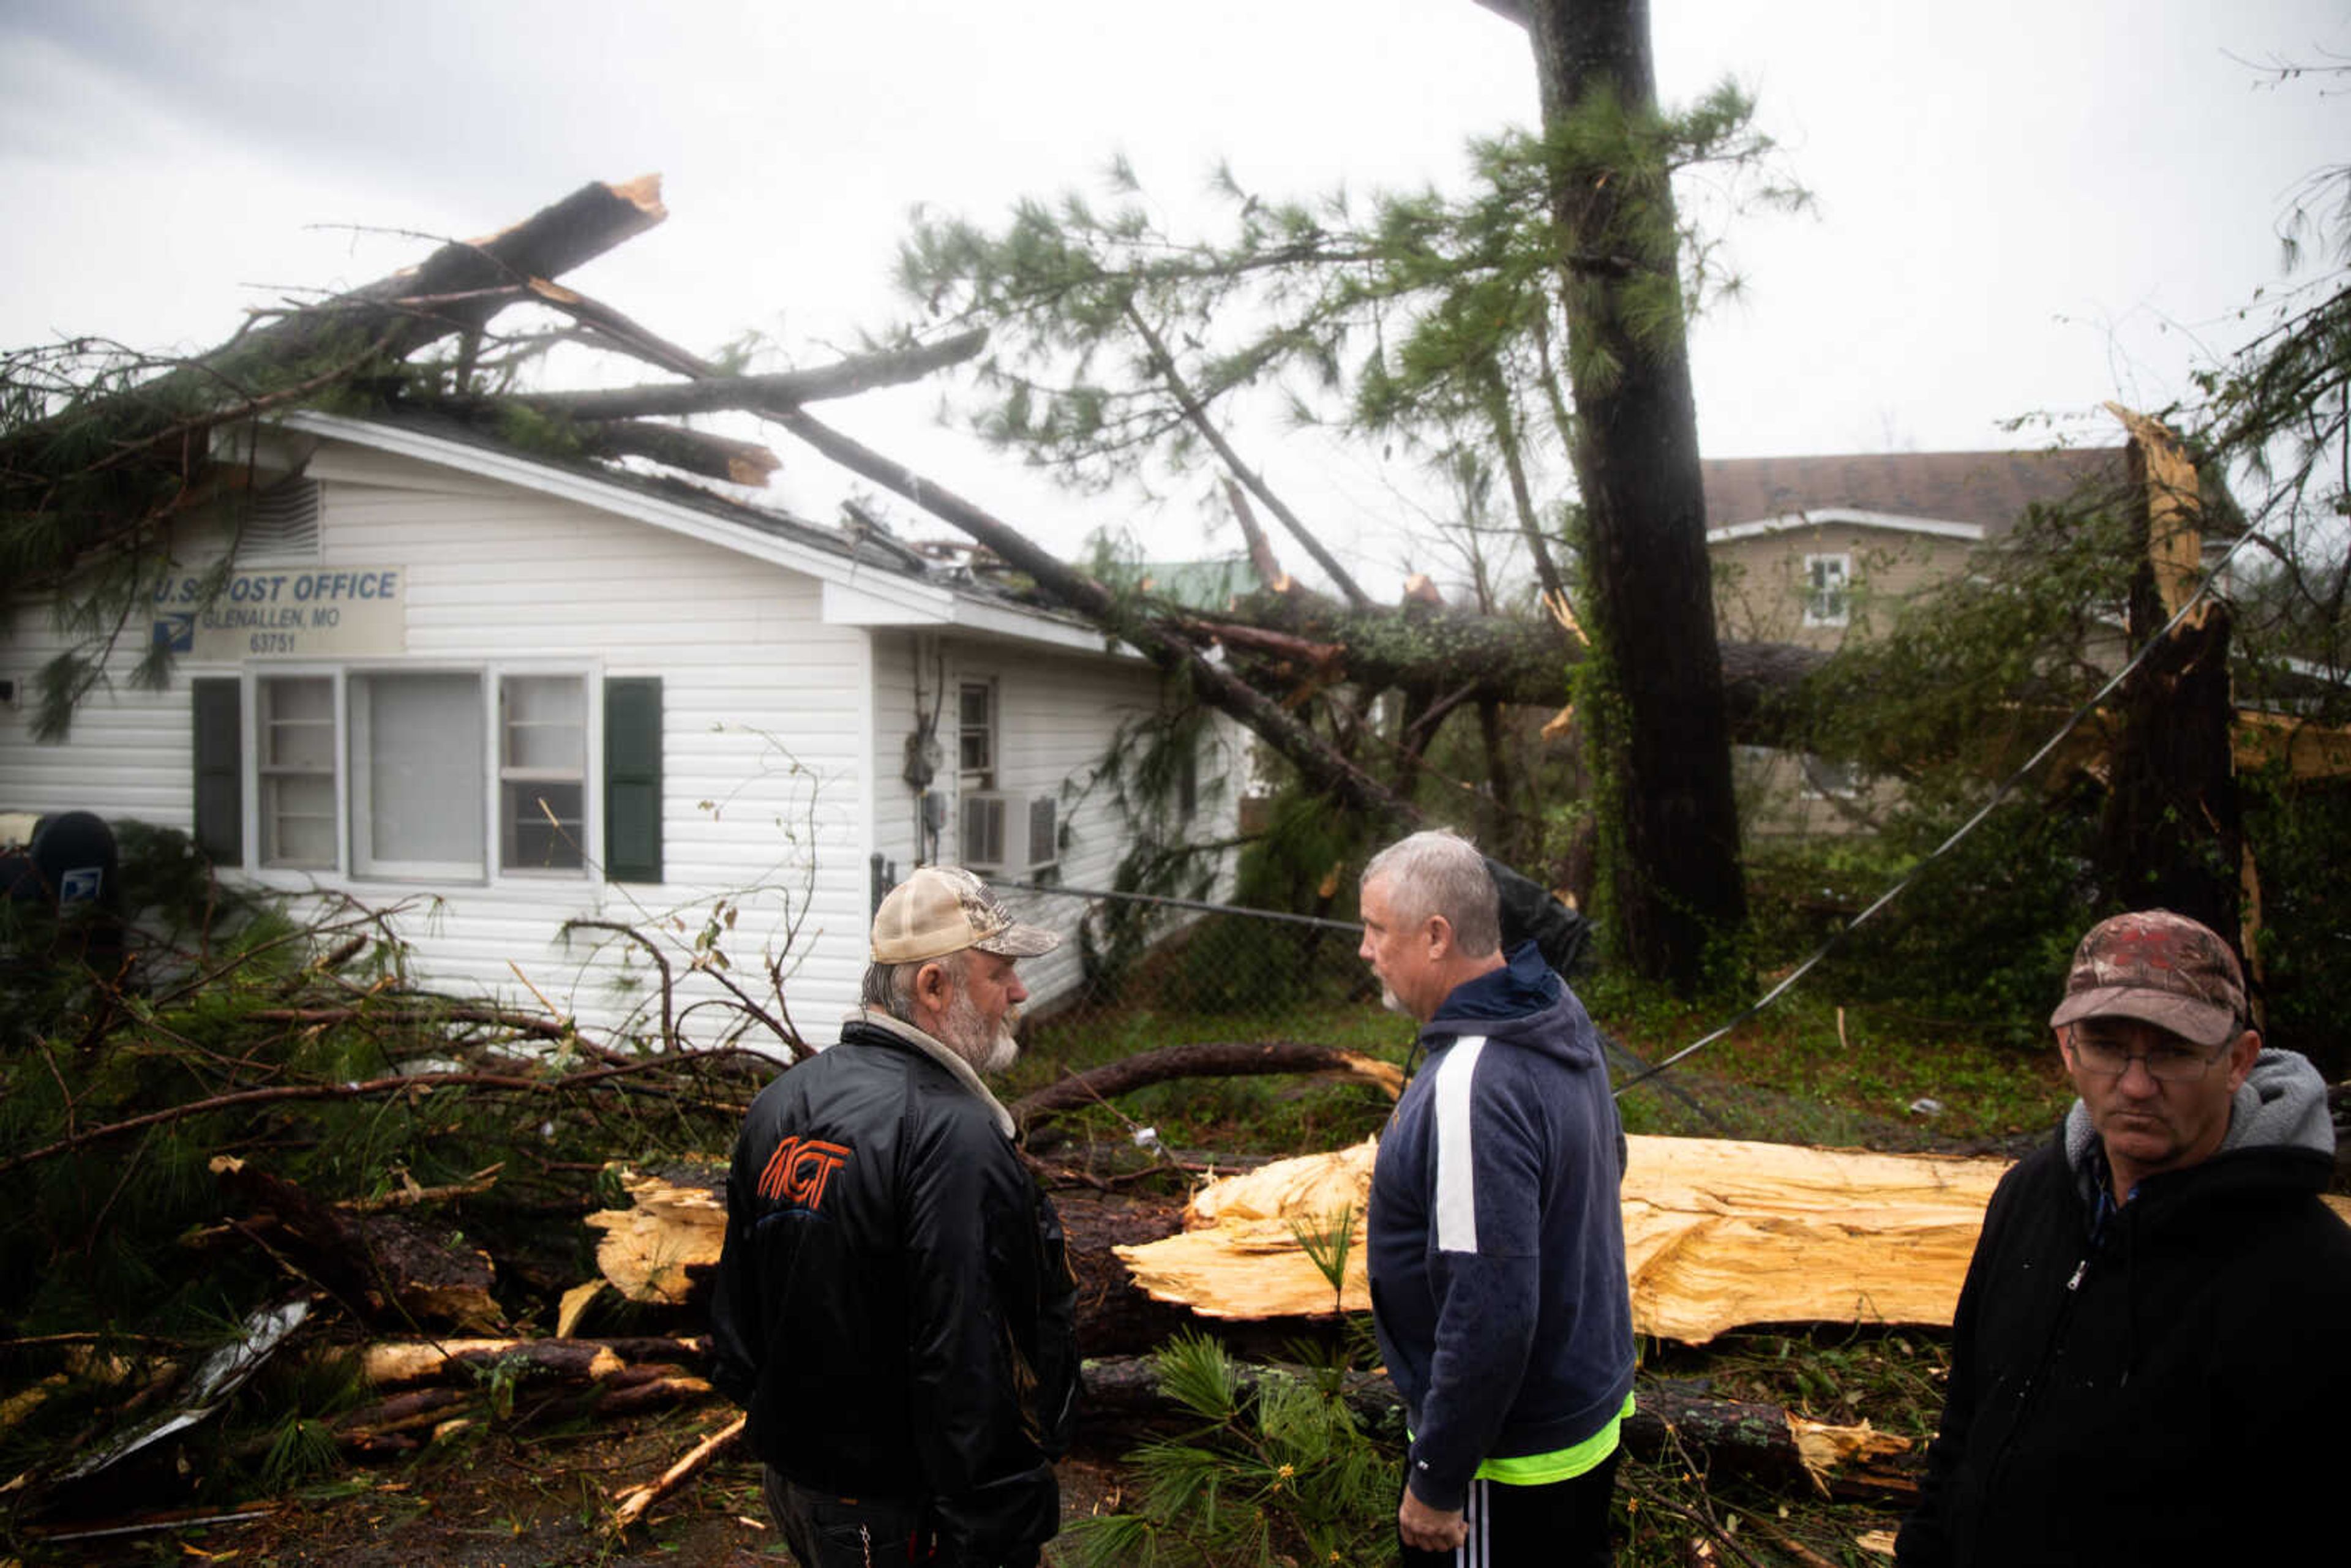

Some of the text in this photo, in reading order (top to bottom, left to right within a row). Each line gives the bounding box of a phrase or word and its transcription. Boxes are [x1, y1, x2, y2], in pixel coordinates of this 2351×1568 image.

[211, 575, 287, 602] POST
[294, 571, 397, 601] OFFICE
[312, 607, 340, 628] MO
[250, 633, 294, 653] 63751
